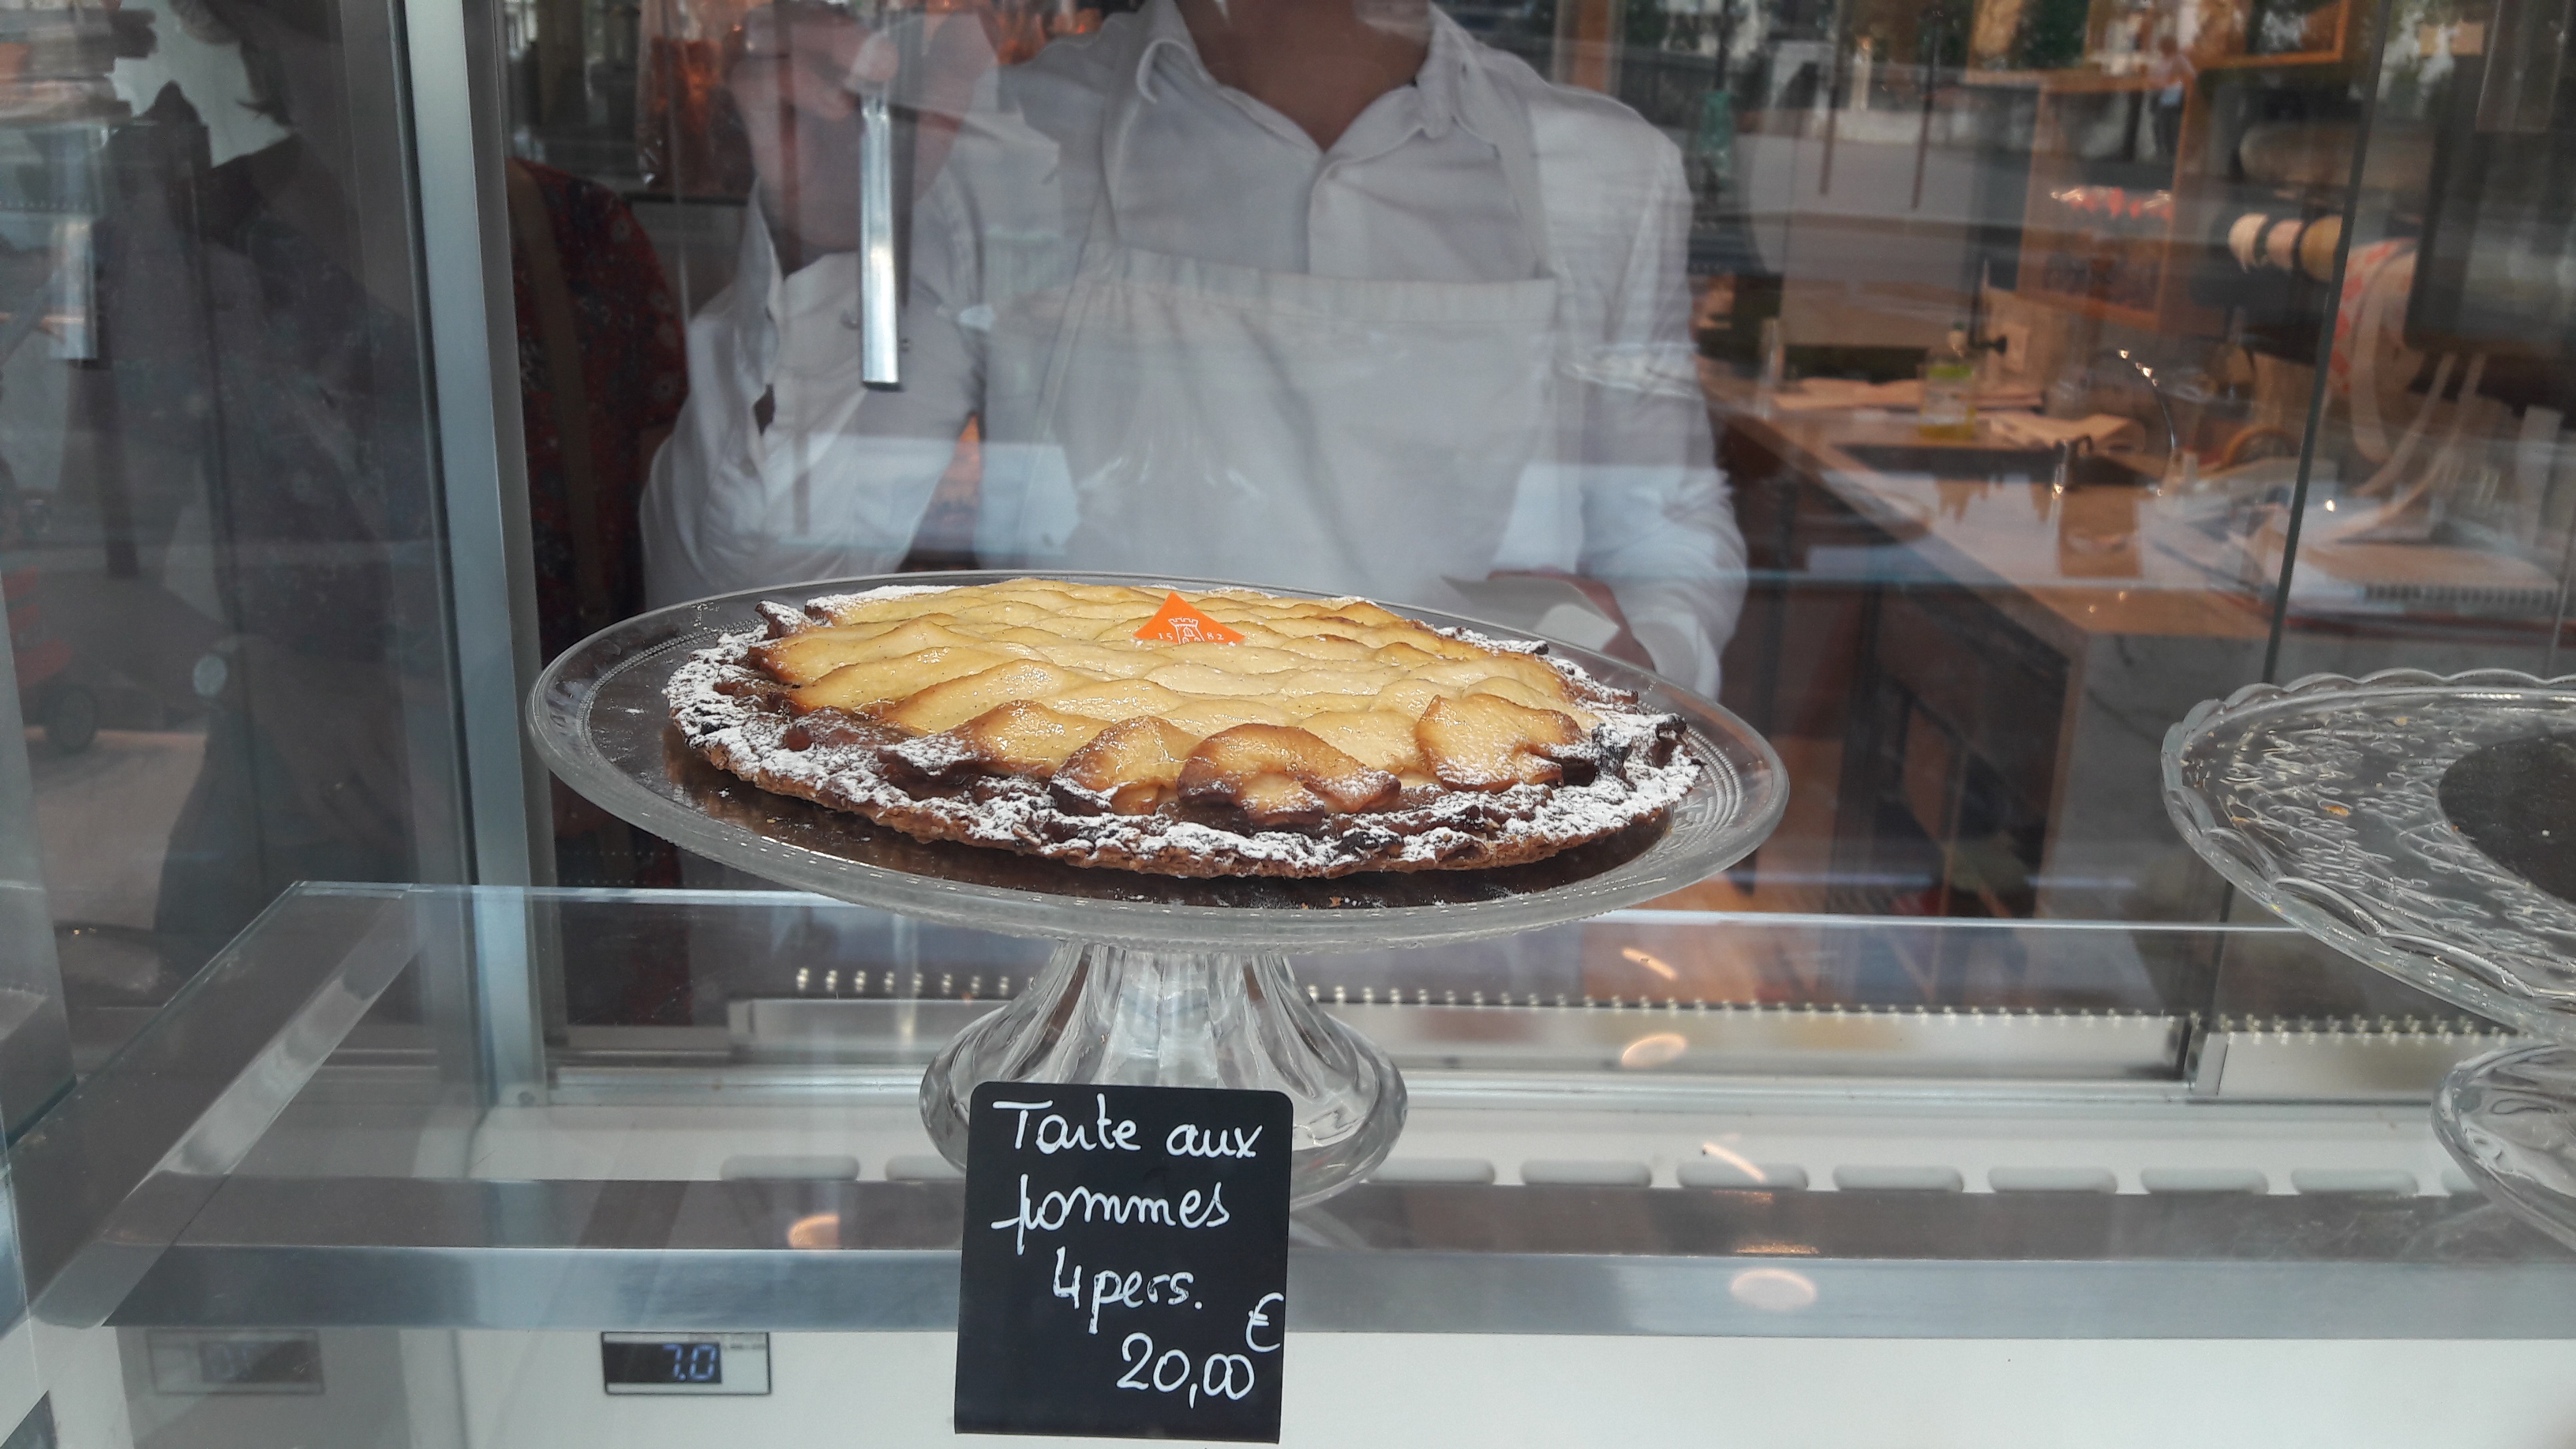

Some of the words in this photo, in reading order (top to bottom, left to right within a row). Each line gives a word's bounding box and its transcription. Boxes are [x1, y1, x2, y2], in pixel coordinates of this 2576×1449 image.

[992, 1093, 1141, 1155] Tarte
[1166, 1124, 1263, 1159] aux
[990, 1174, 1230, 1255] pommes
[663, 1343, 717, 1381] 7.0
[1116, 1332, 1256, 1409] 20,00
[1245, 1292, 1284, 1352] €
